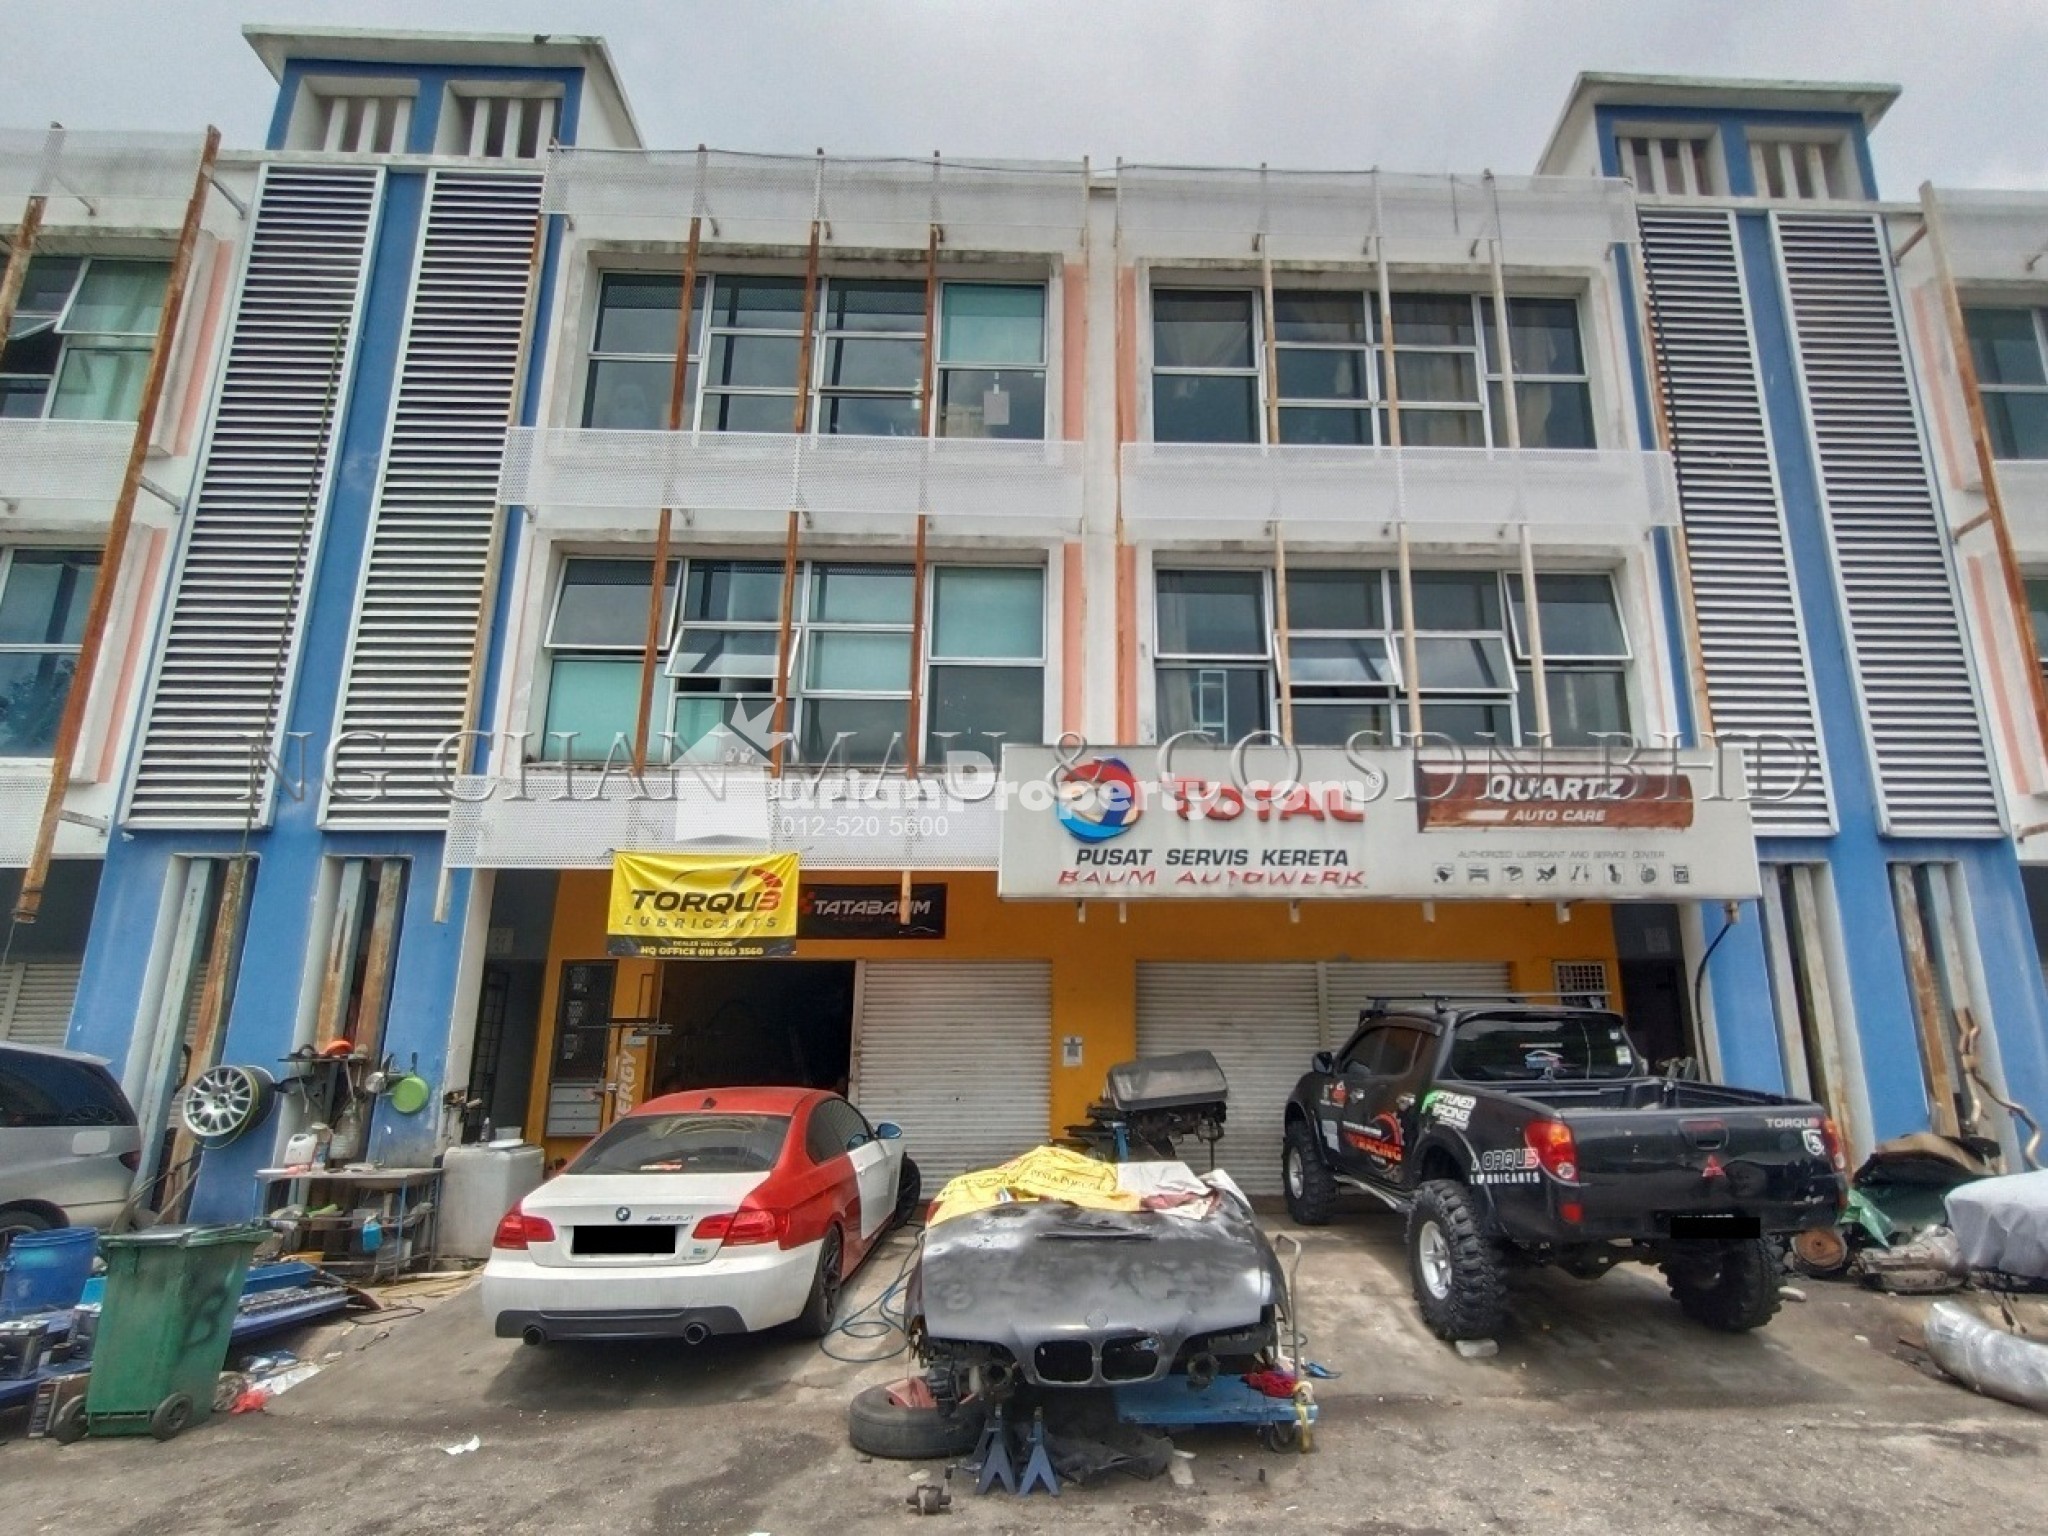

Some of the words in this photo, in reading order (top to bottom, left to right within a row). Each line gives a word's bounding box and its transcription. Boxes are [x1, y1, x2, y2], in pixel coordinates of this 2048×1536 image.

[1490, 774, 1625, 802] QUARTZ
[1512, 810, 1557, 822] AUTO
[1562, 809, 1606, 822] CARE
[1075, 848, 1152, 866] PUSAT
[1165, 848, 1248, 866] SERVIS
[1261, 848, 1349, 867] KERETA
[1569, 850, 1590, 859] AND
[1593, 850, 1627, 859] SERVICE
[1632, 850, 1666, 859] CENTER
[1057, 869, 1157, 886] BAUM
[814, 899, 932, 916] TATABAM
[624, 914, 779, 930] LUBRICANTS
[659, 946, 697, 956] OFFICE
